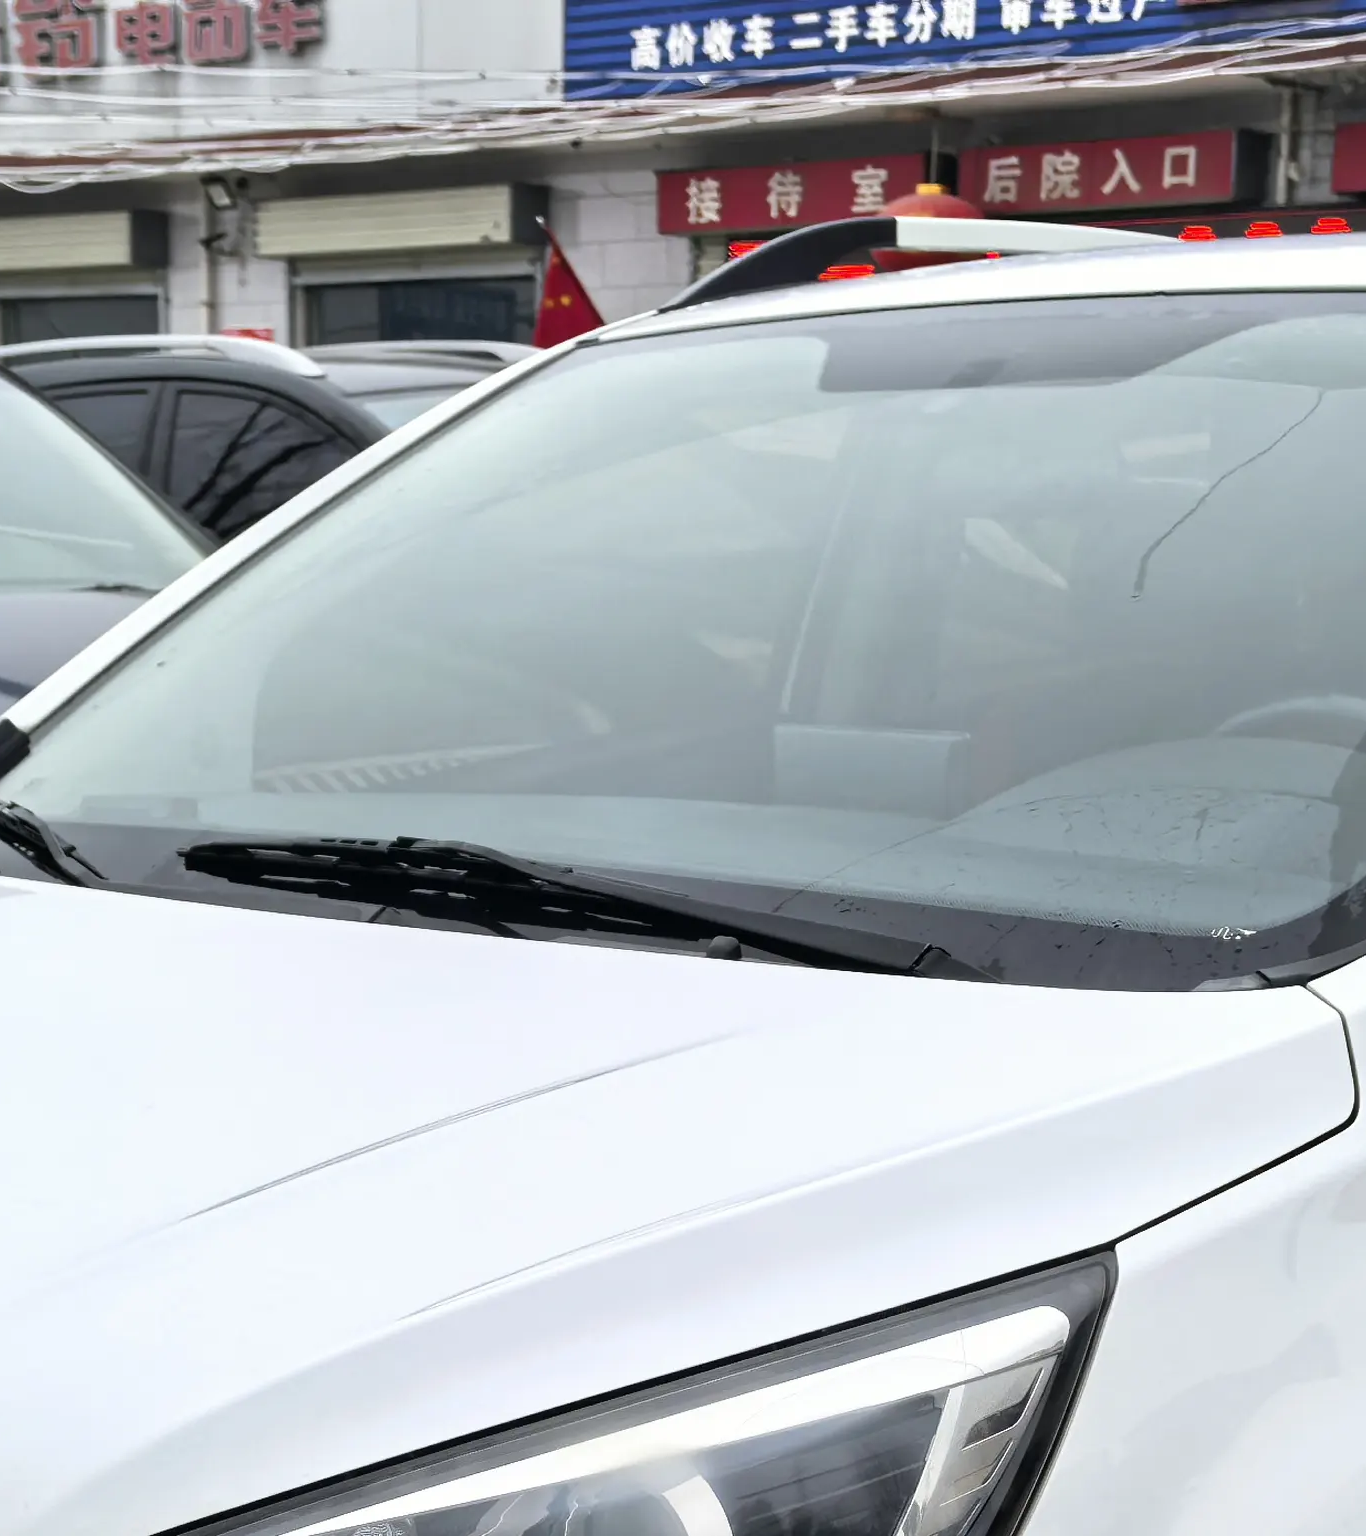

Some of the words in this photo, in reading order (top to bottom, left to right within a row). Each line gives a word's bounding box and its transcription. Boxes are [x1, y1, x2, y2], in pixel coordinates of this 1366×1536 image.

[629, 16, 776, 71] 高价收车
[789, 0, 977, 53] 二手车分期
[685, 165, 889, 225] 接待室
[983, 146, 1198, 202] 后院入口
